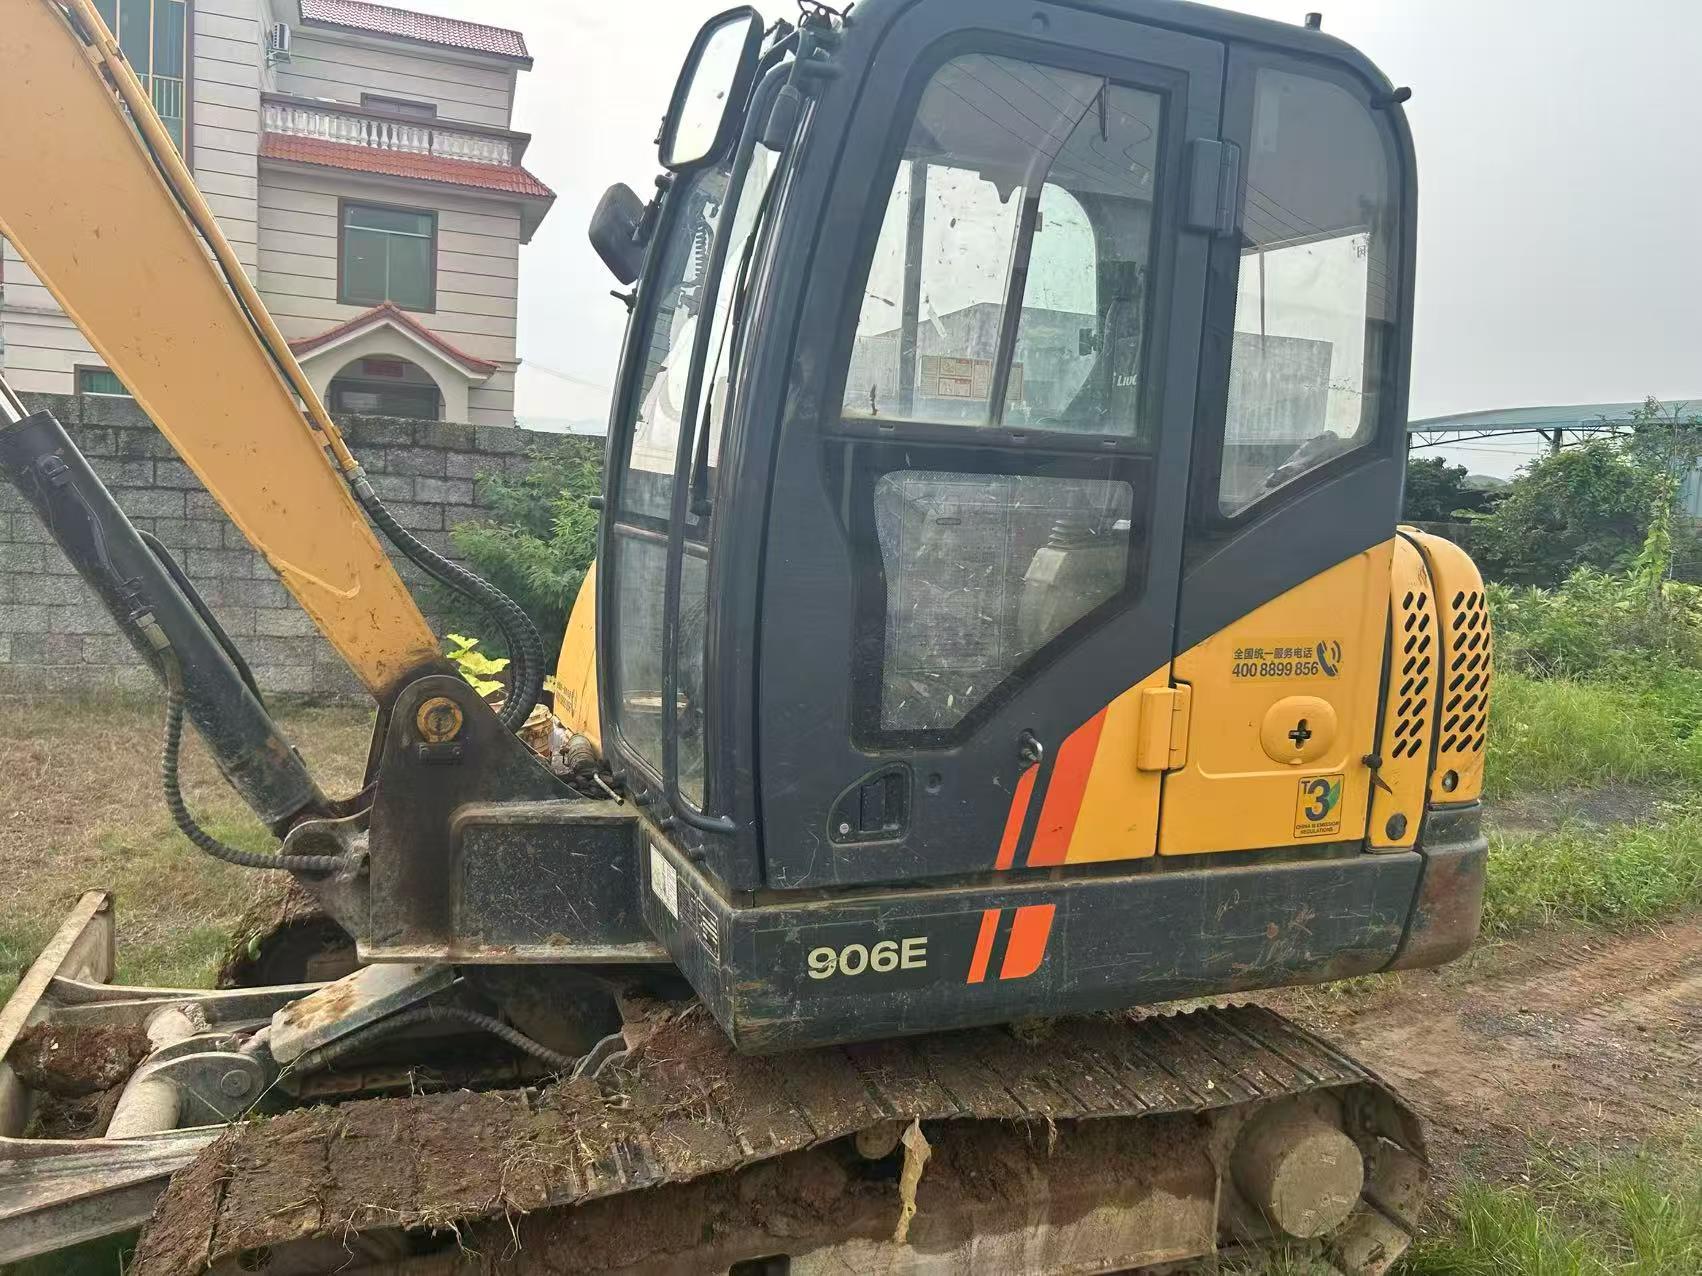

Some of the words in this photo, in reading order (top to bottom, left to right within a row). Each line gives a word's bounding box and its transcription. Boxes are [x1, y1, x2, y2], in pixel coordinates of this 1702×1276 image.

[1233, 647, 1313, 660] 全国统一服务电话
[1232, 662, 1258, 677] 400
[1259, 662, 1293, 677] 8899
[1294, 661, 1319, 676] 856
[807, 936, 928, 979] 906E
